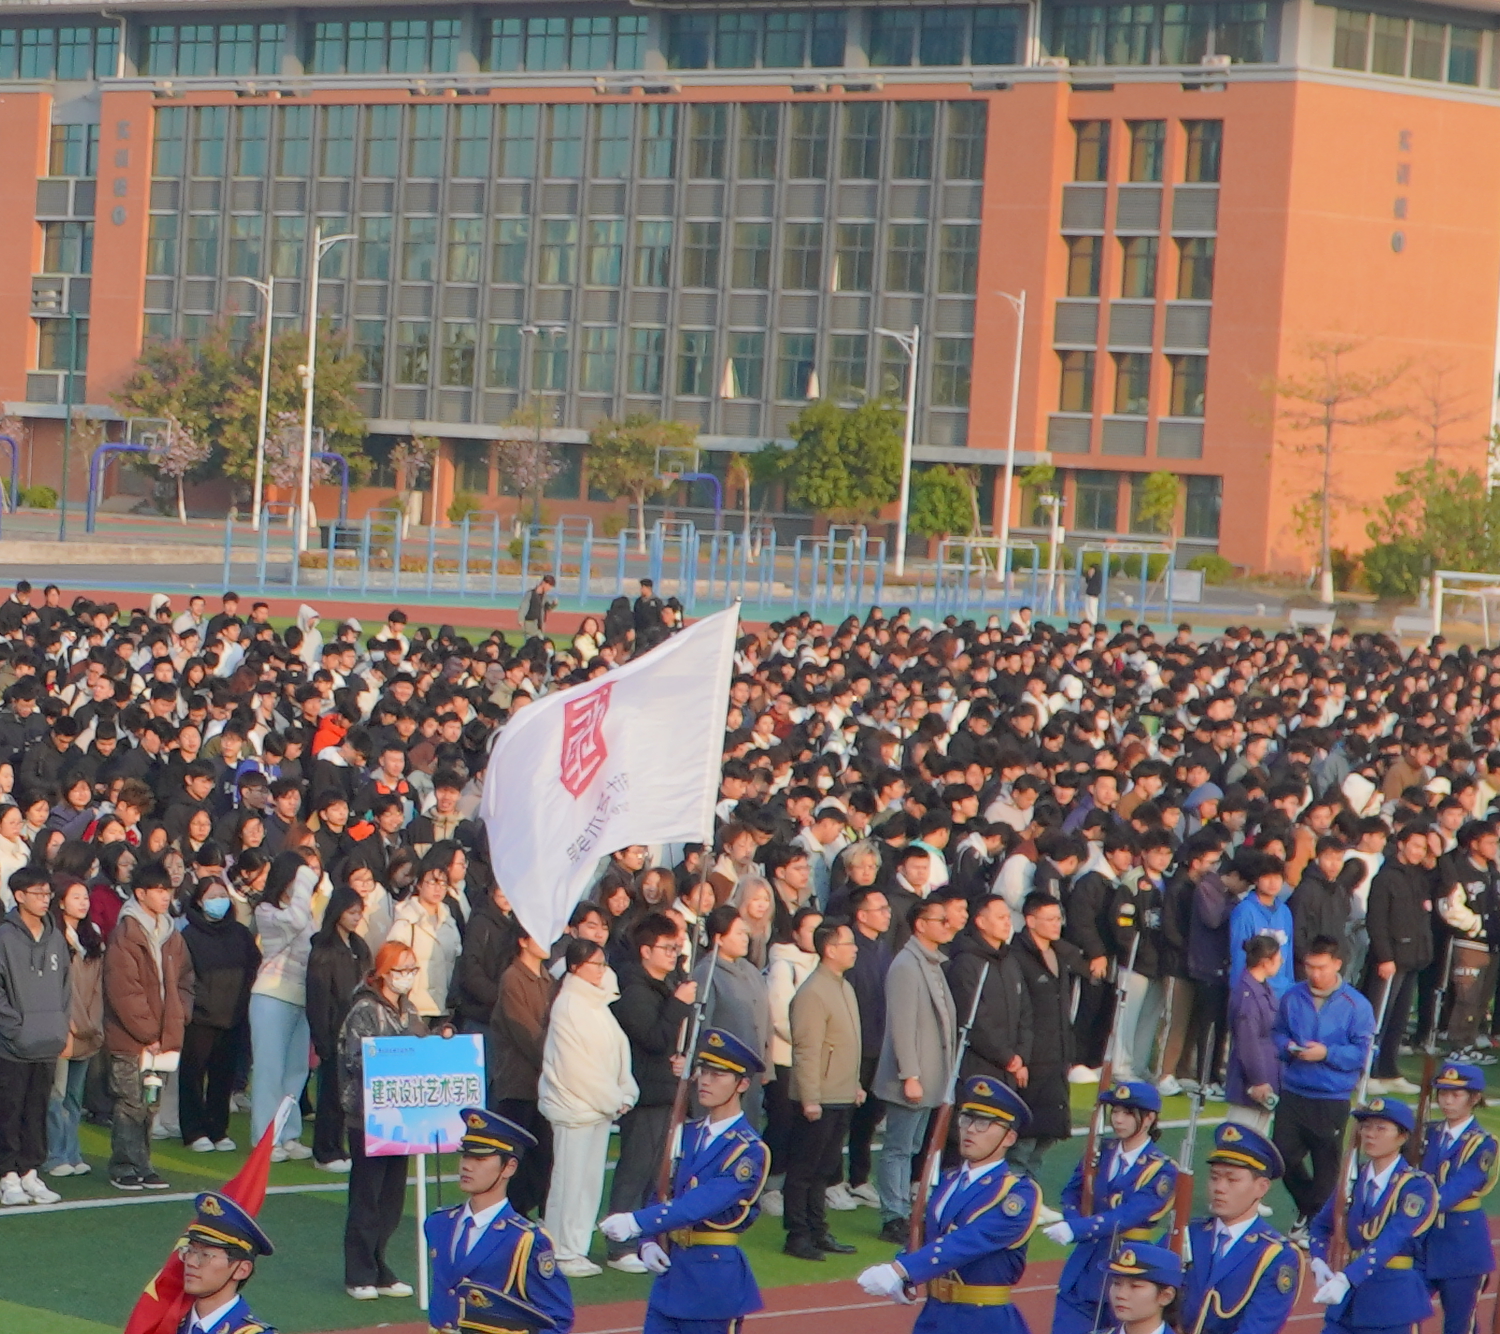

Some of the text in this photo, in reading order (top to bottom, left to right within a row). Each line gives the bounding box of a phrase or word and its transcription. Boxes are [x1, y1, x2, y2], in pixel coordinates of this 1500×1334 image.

[371, 1075, 480, 1107] 建筑设计艺术学院
